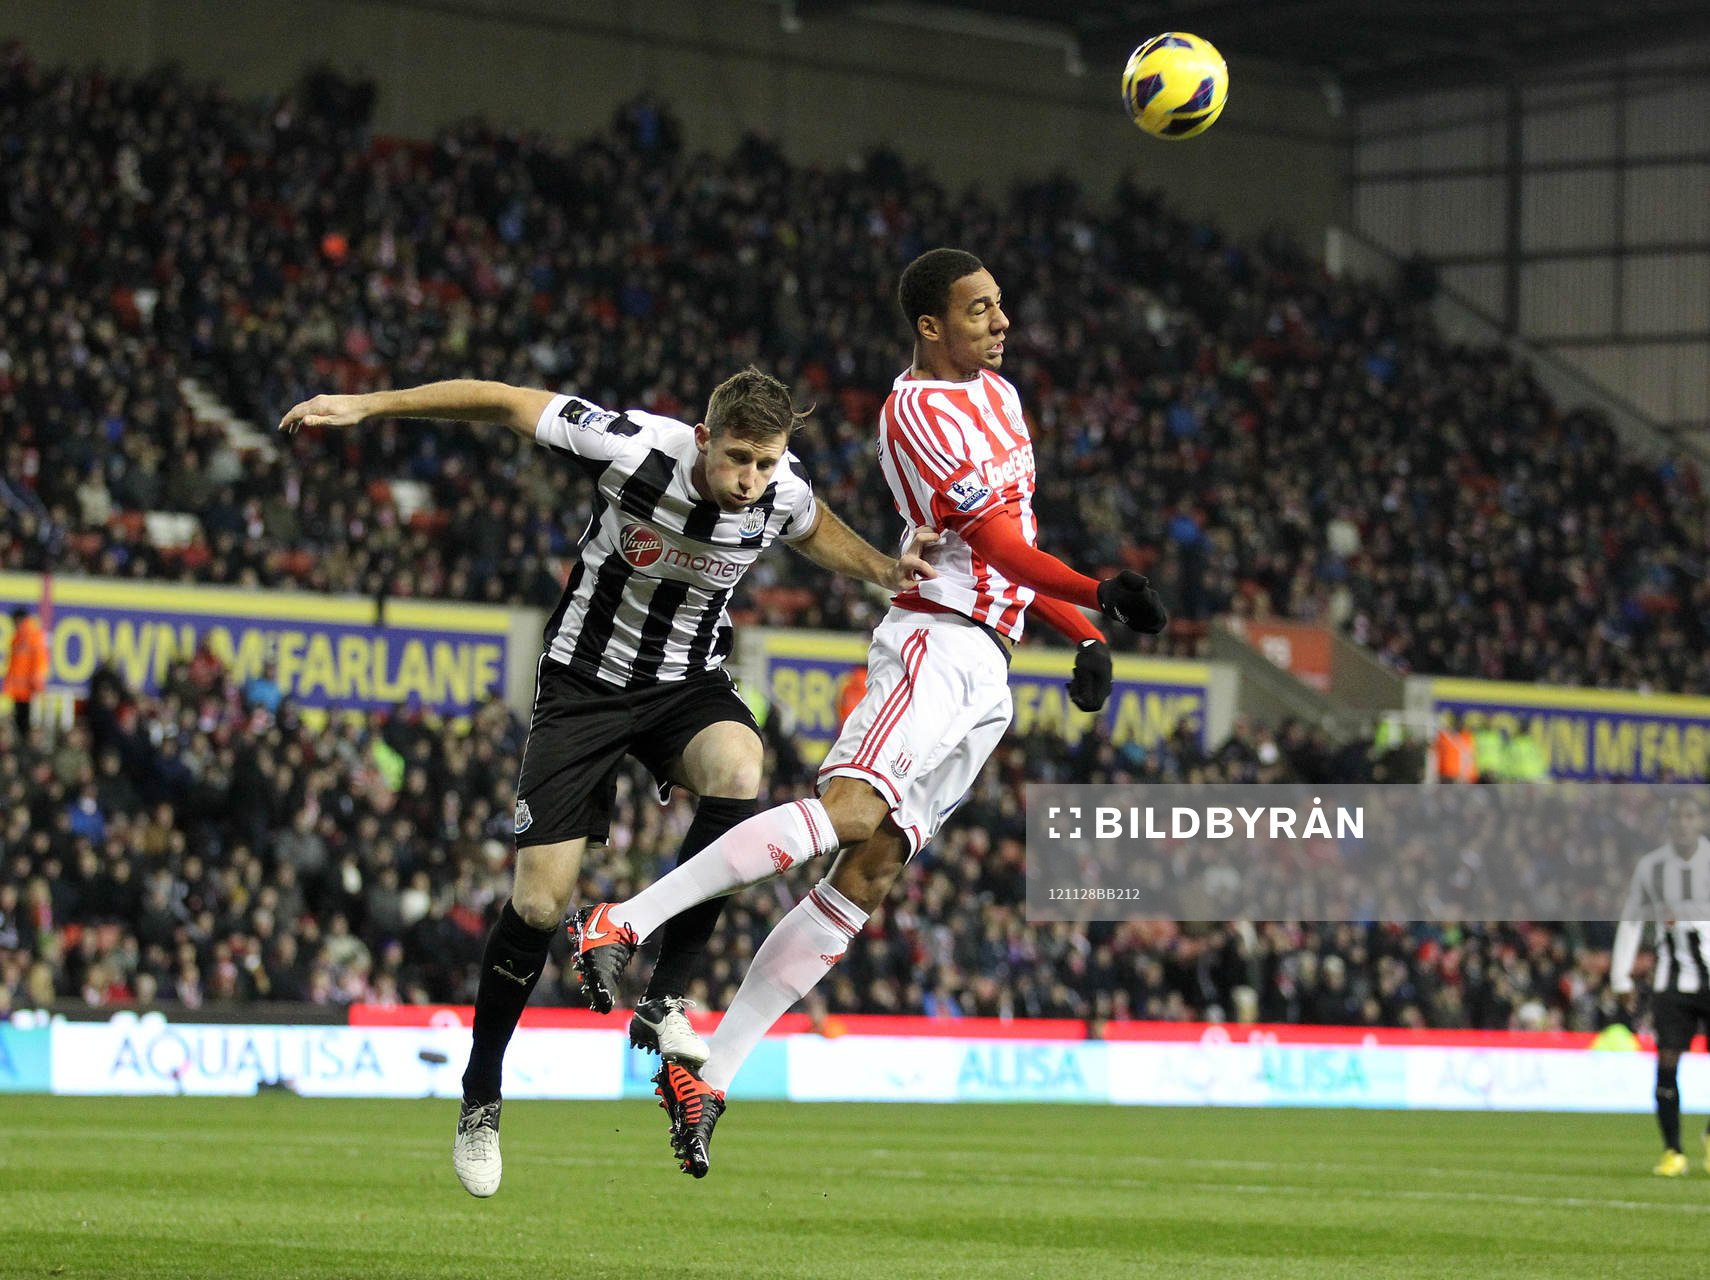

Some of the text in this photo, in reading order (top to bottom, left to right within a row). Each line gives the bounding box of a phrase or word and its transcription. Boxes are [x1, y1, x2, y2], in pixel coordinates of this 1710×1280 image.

[620, 526, 661, 562] Virgin
[0, 612, 197, 691] OWN
[110, 1029, 384, 1080] AQUALISA
